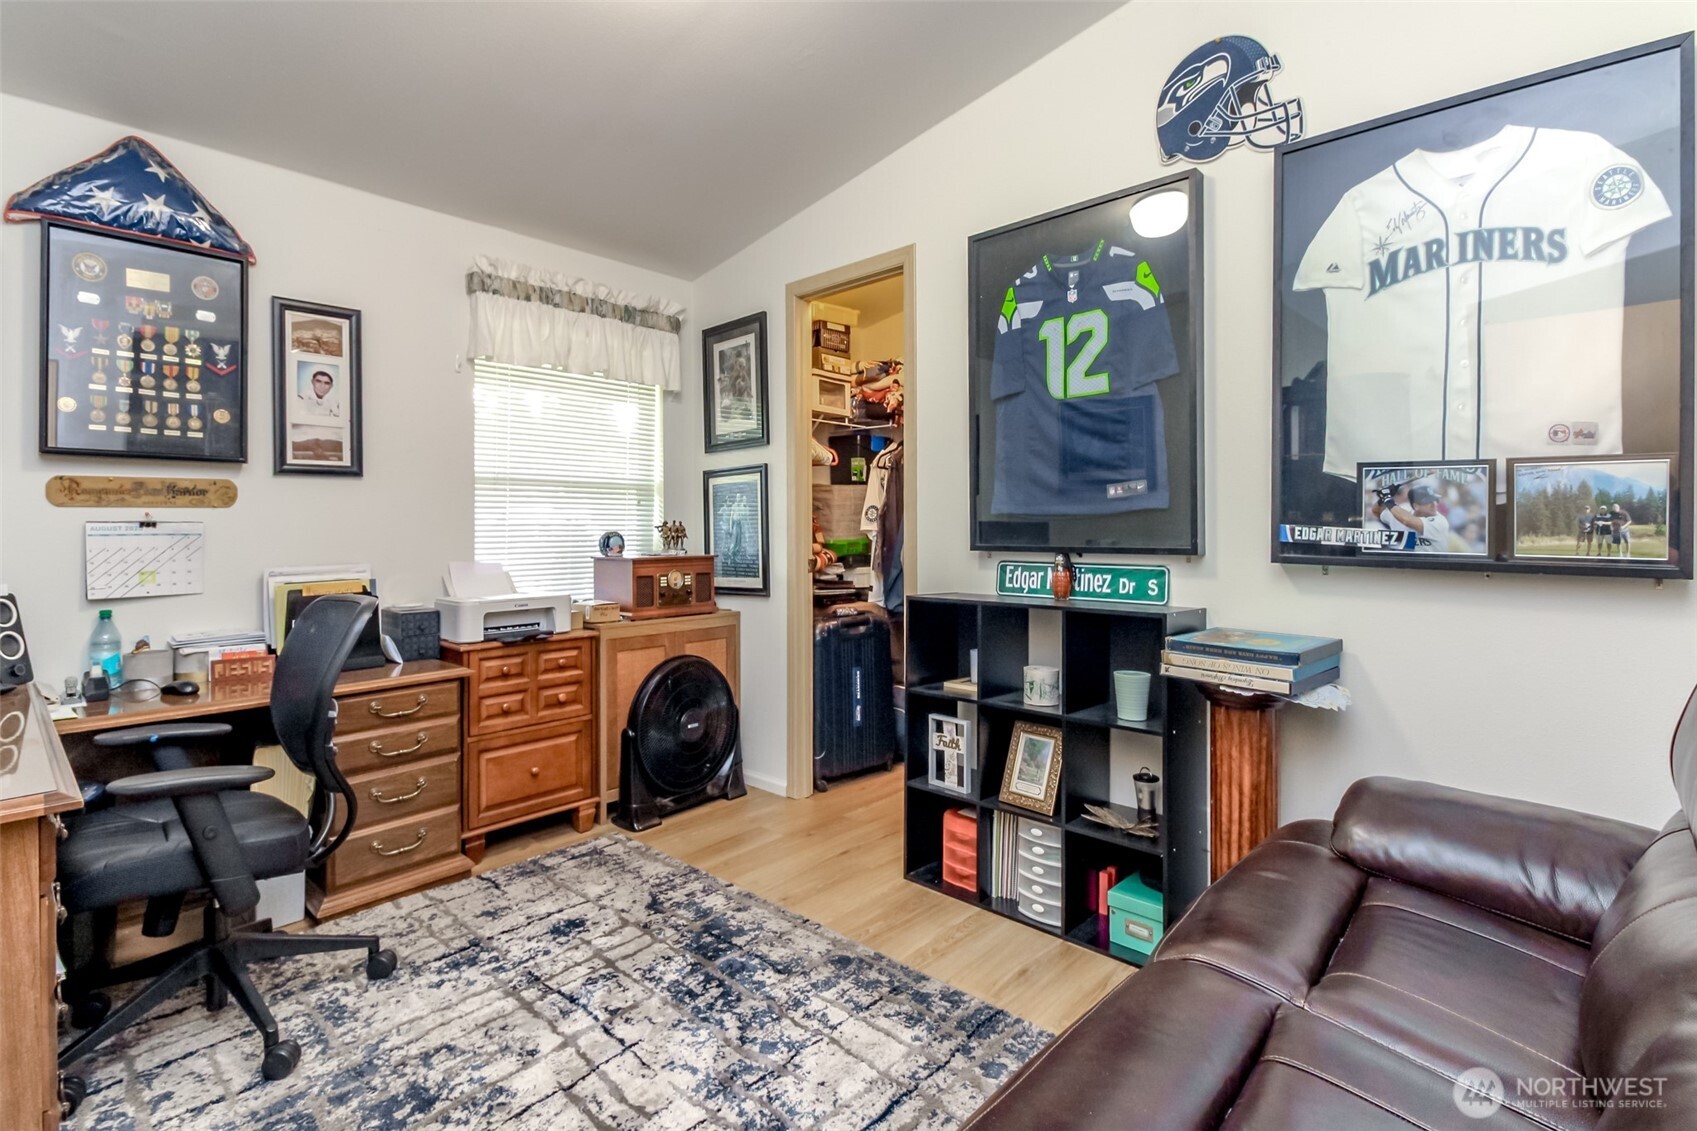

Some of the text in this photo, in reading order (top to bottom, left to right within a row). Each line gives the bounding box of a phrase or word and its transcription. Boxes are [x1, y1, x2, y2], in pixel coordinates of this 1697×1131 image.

[1365, 226, 1568, 302] MARINERS
[1037, 307, 1111, 400] 12
[1381, 471, 1411, 487] HALL
[90, 525, 123, 533] AUGUST
[1293, 528, 1333, 542] EDGAR
[1335, 531, 1399, 546] MARTINEZ
[1005, 566, 1159, 596] Edgar tinez Dr S
[1182, 657, 1270, 676] ON WINGS OF SONG
[935, 734, 962, 751] Faith
